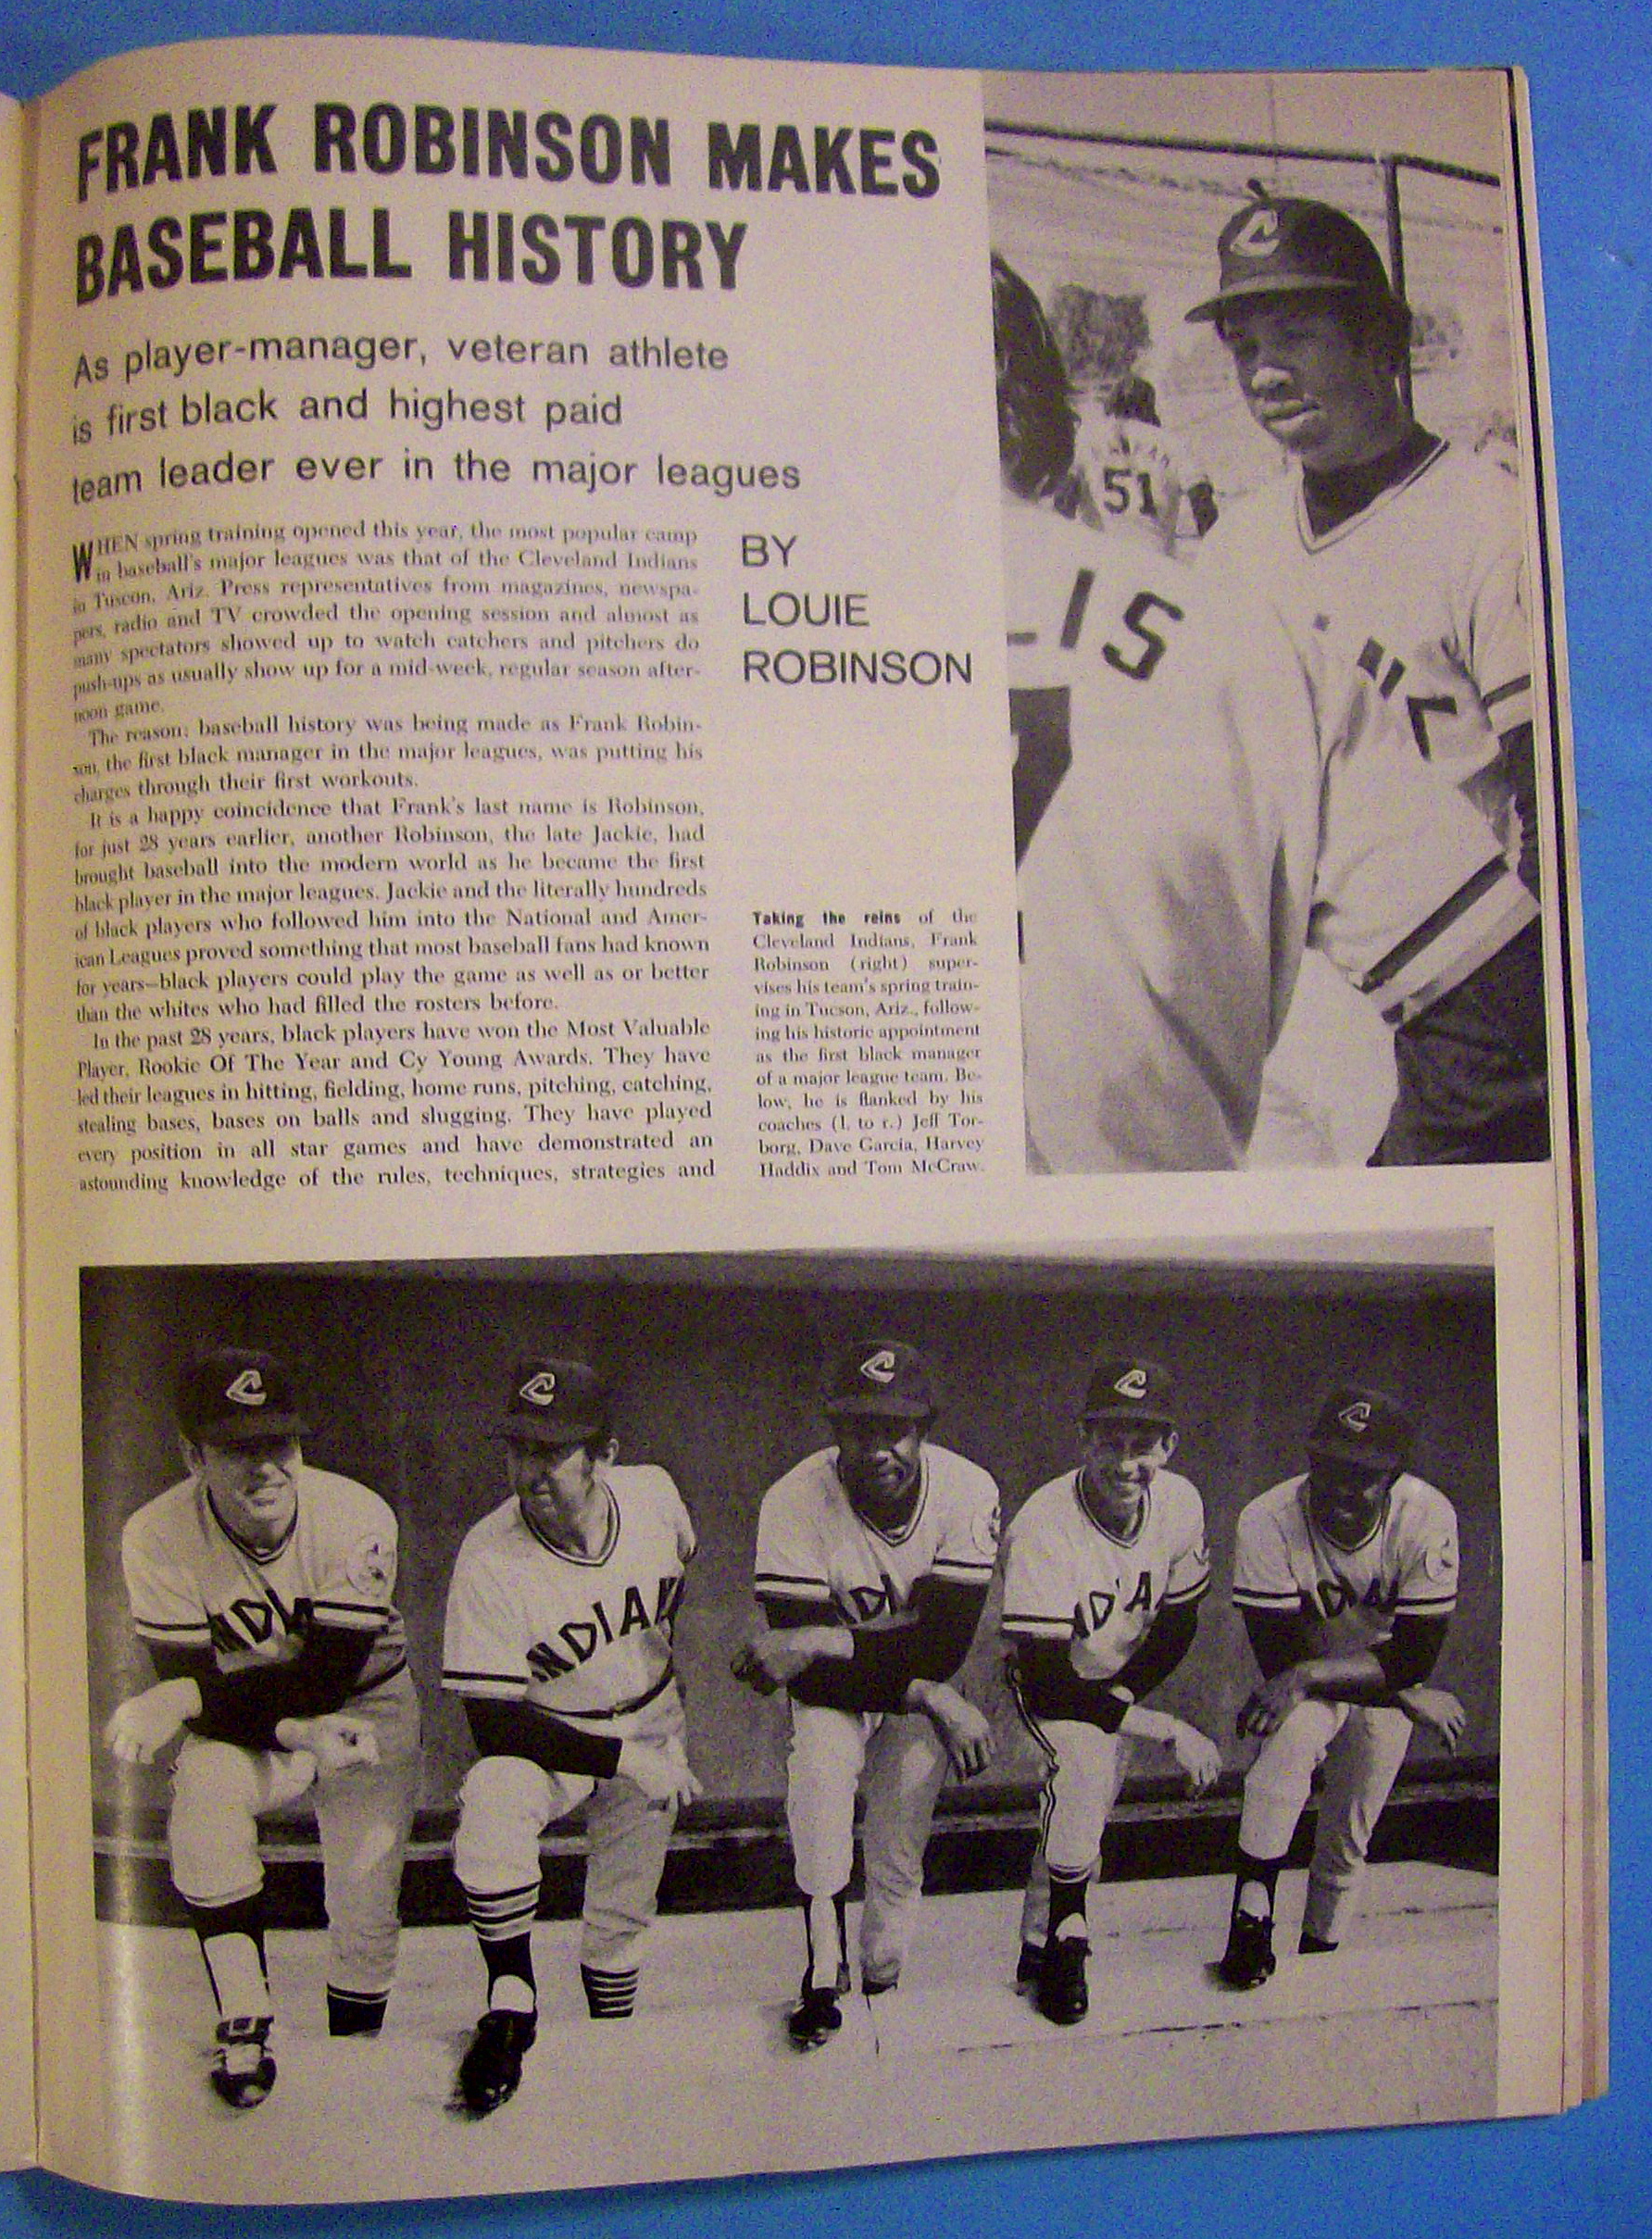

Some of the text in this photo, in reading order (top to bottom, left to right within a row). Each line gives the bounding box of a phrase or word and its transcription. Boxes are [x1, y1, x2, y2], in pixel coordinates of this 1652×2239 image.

[78, 102, 940, 204] FRANK ROBINSON MAKES
[77, 207, 747, 306] BASEBALL HISTORY
[74, 334, 728, 388] As player-manager, veteran athlete
[73, 389, 621, 444] is first black and highest paid
[72, 448, 800, 505] team leader ever in the major leagues
[1103, 466, 1156, 515] 51
[742, 534, 796, 568] BY
[744, 592, 870, 627] LOUIE
[72, 631, 699, 669] many spectators showed up to watch catchers and pitchers do
[744, 649, 971, 686] ROBINSON
[90, 811, 103, 829] It
[109, 811, 121, 826] is
[130, 814, 139, 825] a
[147, 805, 204, 825] happy
[213, 799, 332, 819] coincidence
[341, 797, 381, 815] that
[475, 797, 508, 814] last
[519, 803, 572, 814] name
[582, 799, 597, 814] is
[753, 907, 978, 928] Taking the reins of the
[753, 933, 834, 948] Cleveland
[931, 931, 977, 946] Frank
[754, 957, 830, 971] Robinson
[754, 981, 792, 994] vises
[796, 979, 820, 994] his
[881, 980, 930, 998] spring
[76, 1005, 108, 1022] than
[115, 1003, 142, 1020] the
[149, 1000, 209, 1017] whites
[218, 997, 260, 1015] who
[269, 995, 306, 1014] had
[315, 994, 365, 1013] filled
[374, 994, 407, 1011] the
[415, 996, 481, 1010] rosters
[754, 1005, 780, 1021] ing
[785, 1005, 801, 1017] in
[755, 1024, 980, 1044] ing his historic appointment
[139, 1057, 200, 1074] Rookie
[209, 1056, 234, 1071] Of
[244, 1054, 285, 1071] The
[295, 1053, 338, 1069] Year
[350, 1051, 388, 1069] and
[398, 1051, 427, 1071] Cy
[438, 1050, 503, 1070] Young
[603, 1046, 651, 1068] They
[665, 1045, 710, 1063] have
[756, 1045, 981, 1064] as the first black manager
[756, 1071, 772, 1085] of
[778, 1076, 787, 1085] a
[793, 1071, 841, 1089] major
[845, 1069, 898, 1089] league
[803, 1093, 823, 1107] he
[835, 1094, 847, 1107] is
[858, 1091, 918, 1107] flanked
[929, 1090, 949, 1108] by
[960, 1090, 983, 1104] his
[758, 1116, 822, 1132] coaches
[857, 1117, 875, 1129] to
[911, 1113, 940, 1131] Jeff
[78, 1131, 713, 1168] every position in all star games and have demonstrated an
[809, 1138, 852, 1153] Dave
[926, 1136, 984, 1156] Harvey
[79, 1173, 169, 1195] astounding
[181, 1170, 286, 1193] knowledge
[298, 1169, 318, 1185] of
[332, 1168, 364, 1185] the
[571, 1162, 665, 1184] strategies
[678, 1158, 715, 1177] and
[759, 1161, 820, 1177] Haddix
[828, 1160, 857, 1175] and
[865, 1160, 903, 1175] Tom
